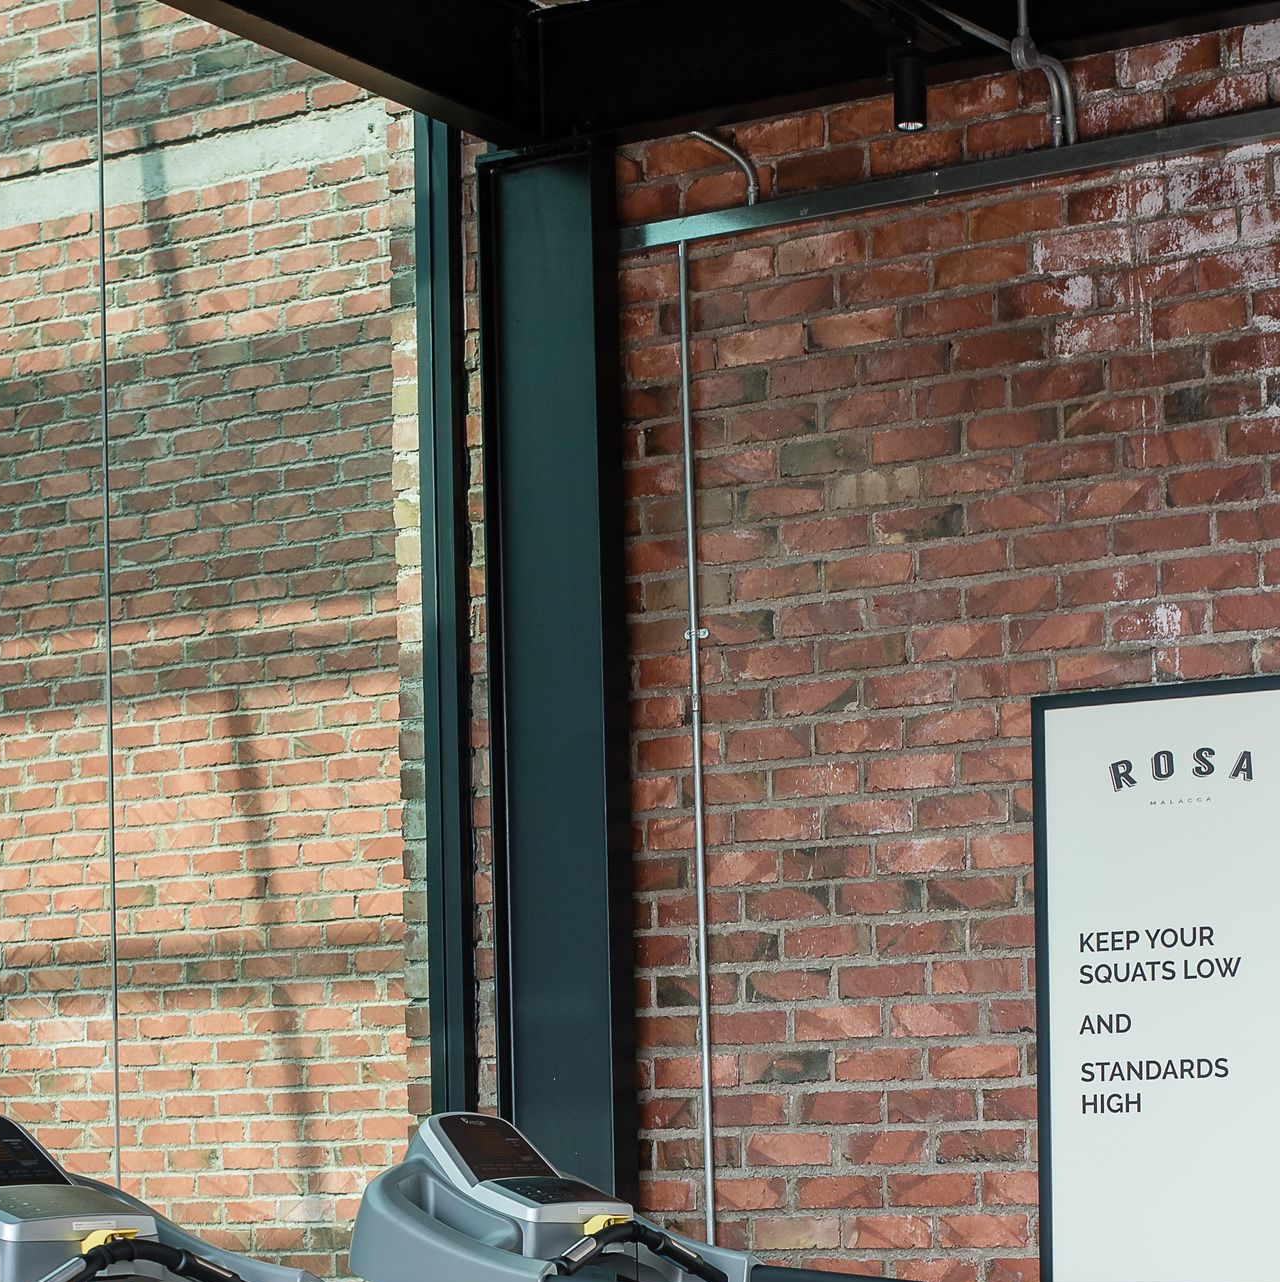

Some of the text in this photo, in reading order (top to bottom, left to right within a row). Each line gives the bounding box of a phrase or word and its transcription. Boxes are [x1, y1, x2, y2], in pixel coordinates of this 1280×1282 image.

[1108, 747, 1253, 792] ROSA
[1149, 797, 1210, 805] MALACCA
[1079, 926, 1214, 952] KEEP YOUR
[1079, 956, 1241, 984] SQUATS LOW
[1079, 1013, 1131, 1035] AND
[1080, 1057, 1228, 1082] STANDARDS
[1081, 1092, 1141, 1114] HIGH
